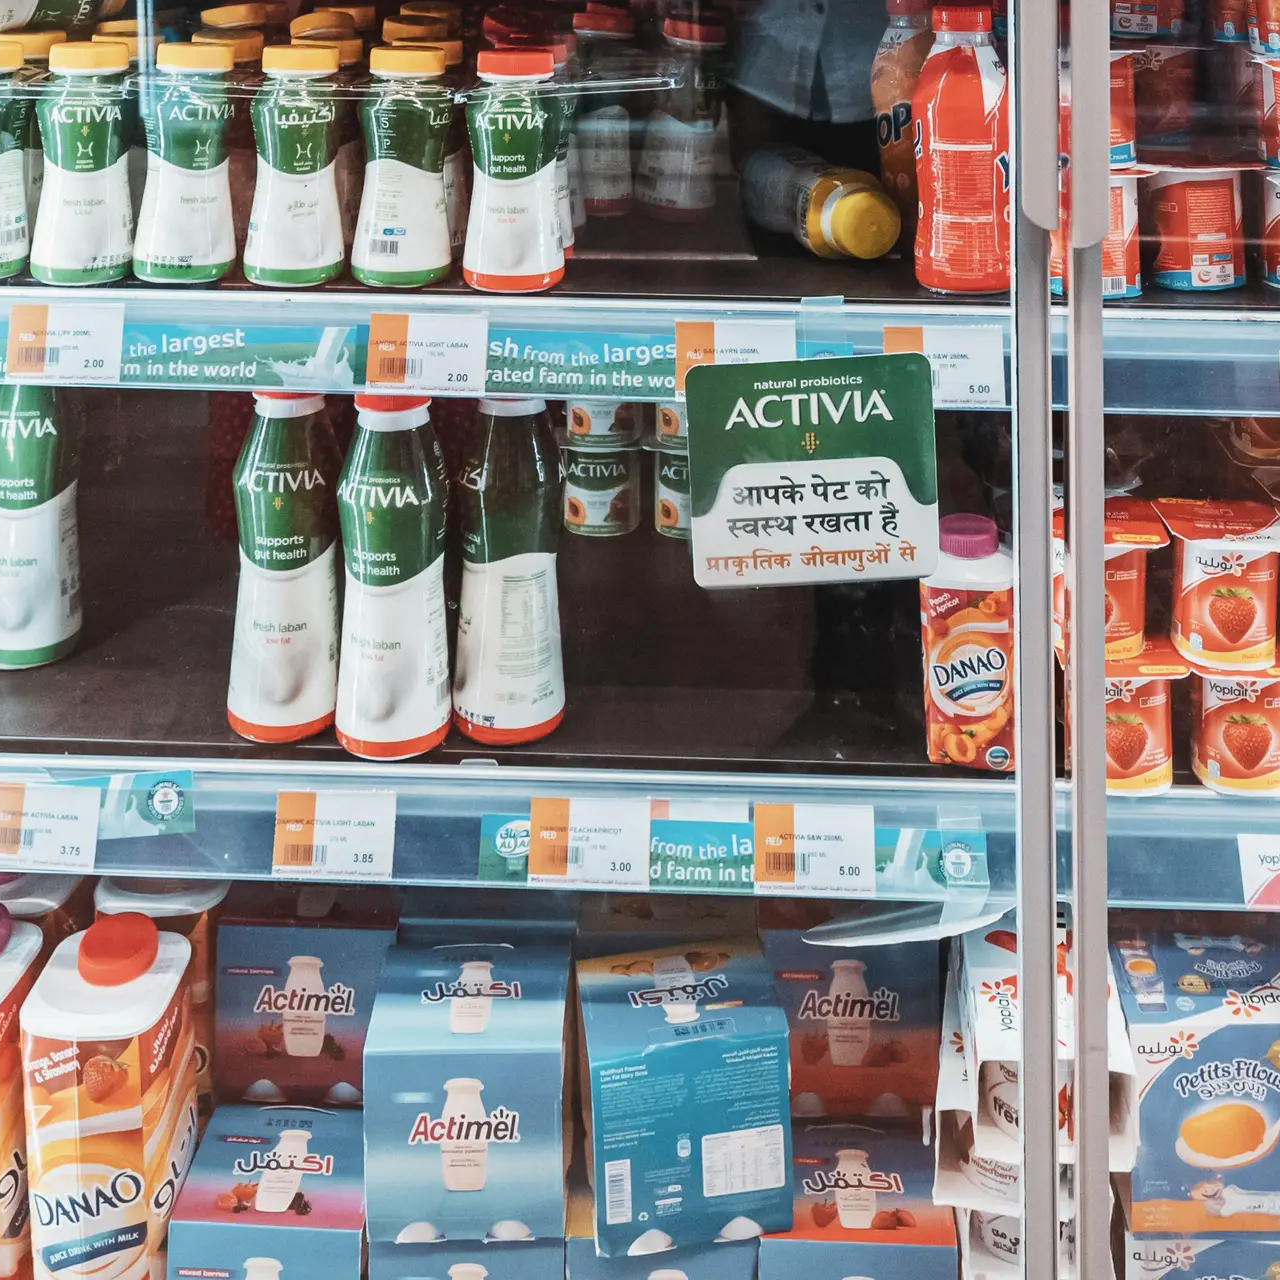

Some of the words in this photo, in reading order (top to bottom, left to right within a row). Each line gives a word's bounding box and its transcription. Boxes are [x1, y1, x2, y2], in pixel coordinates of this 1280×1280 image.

[491, 153, 526, 164] supports
[489, 163, 502, 175] gut
[503, 163, 527, 174] health
[130, 342, 157, 358] the
[161, 329, 245, 354] largest
[83, 359, 104, 369] 2.00
[147, 361, 164, 378] in
[168, 362, 198, 378] the
[204, 362, 257, 379] world
[447, 373, 468, 383] 2.00
[754, 378, 797, 390] natural
[800, 375, 863, 388] probiotics
[725, 389, 894, 431] ACTIVIA
[732, 475, 805, 505] आपके
[809, 473, 849, 503] पेट
[857, 470, 891, 500] को
[727, 513, 798, 538] स्वस्थ
[804, 510, 869, 534] रखता
[881, 503, 900, 539] है
[255, 534, 304, 547] supports
[254, 549, 274, 561] gut
[277, 547, 307, 560] health
[706, 548, 792, 578] प्राकृतिक
[800, 543, 892, 572] जीवाणुओं
[899, 541, 917, 564] से
[929, 592, 951, 607] Peach
[936, 597, 960, 613] Apricot
[277, 621, 308, 632] laban
[934, 648, 1006, 687] DANAO
[60, 846, 81, 856] 3.75
[651, 836, 693, 857] from
[698, 842, 726, 857] the
[353, 854, 374, 863] 3.85
[610, 862, 631, 873] 3.00
[665, 864, 711, 881] farm
[718, 866, 734, 881] in
[839, 866, 861, 876] 5.00
[256, 984, 354, 1013] Actimel
[800, 988, 898, 1021] Actimel
[1176, 1062, 1231, 1095] Petits
[413, 1108, 518, 1143] Actimel
[35, 1171, 144, 1228] DANAO
[118, 1231, 140, 1245] MILK
